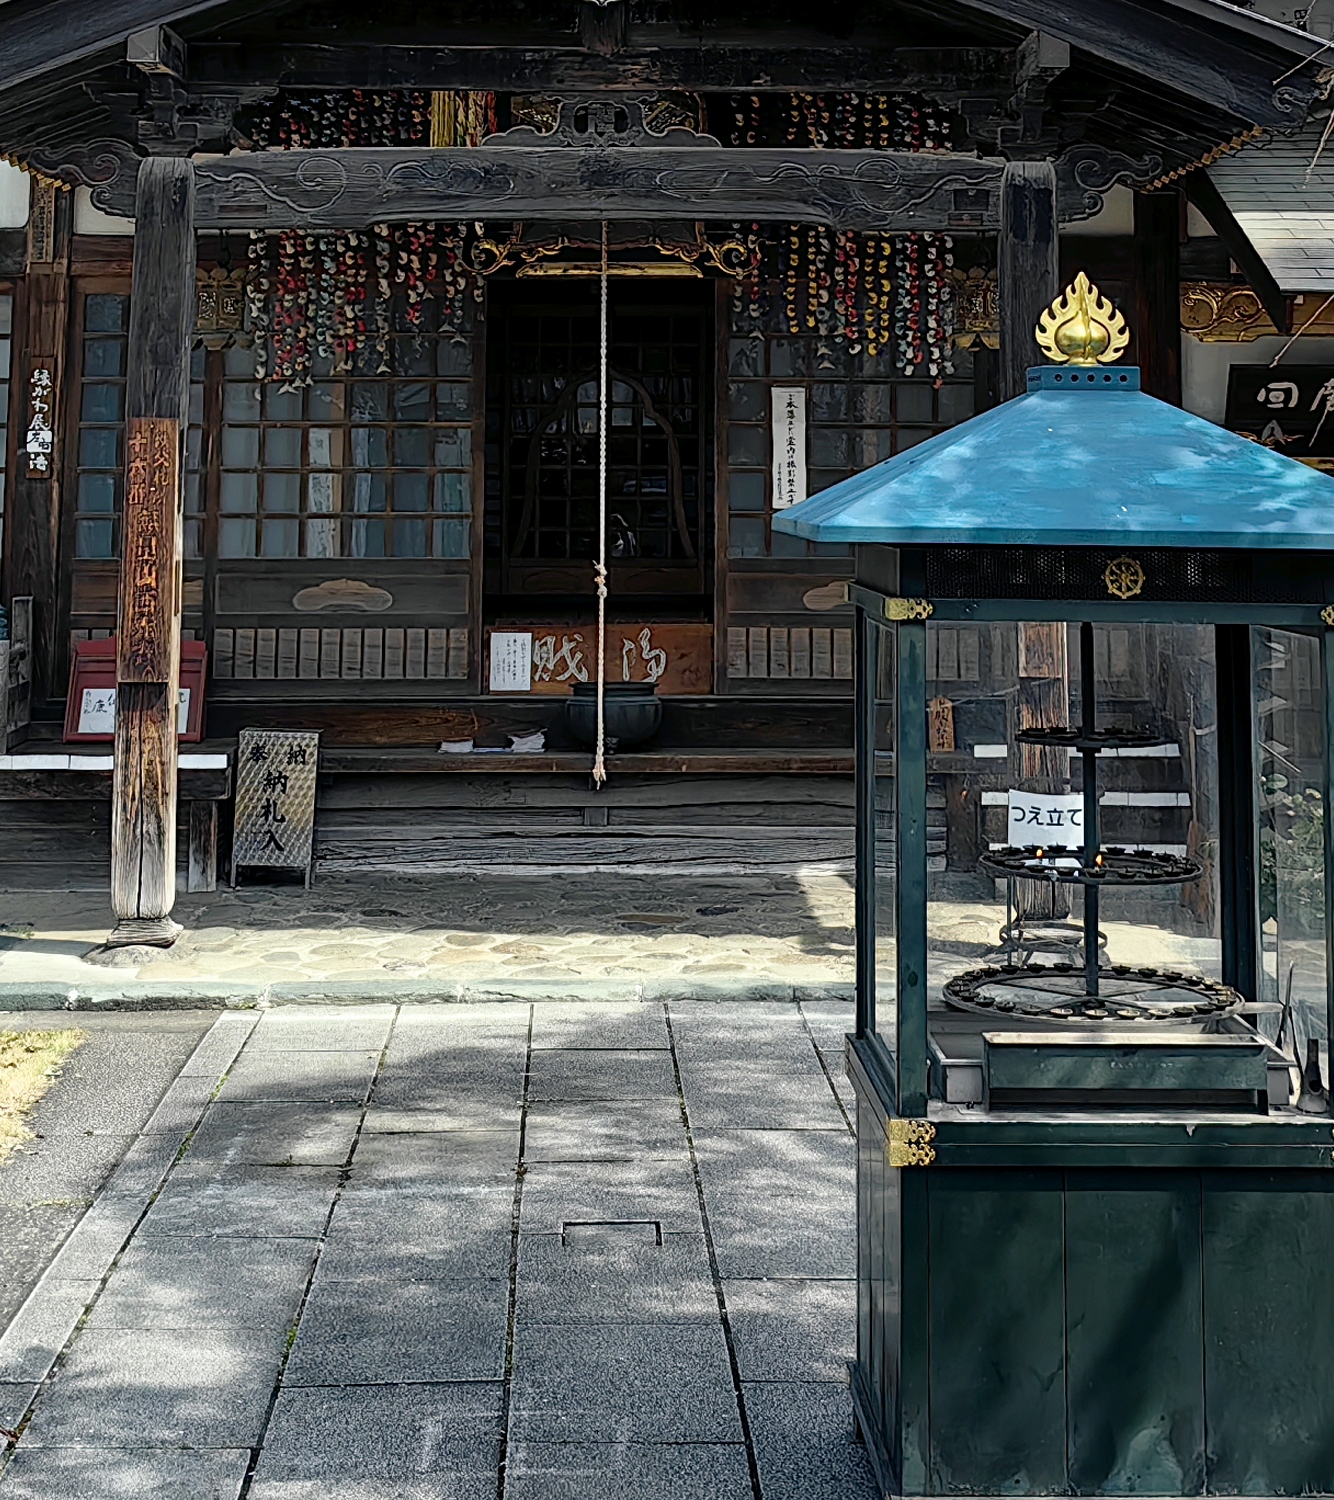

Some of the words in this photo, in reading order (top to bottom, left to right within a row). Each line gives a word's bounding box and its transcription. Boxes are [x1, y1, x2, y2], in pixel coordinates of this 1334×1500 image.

[253, 770, 290, 852] 納札入
[1010, 805, 1083, 827] つえ立て
